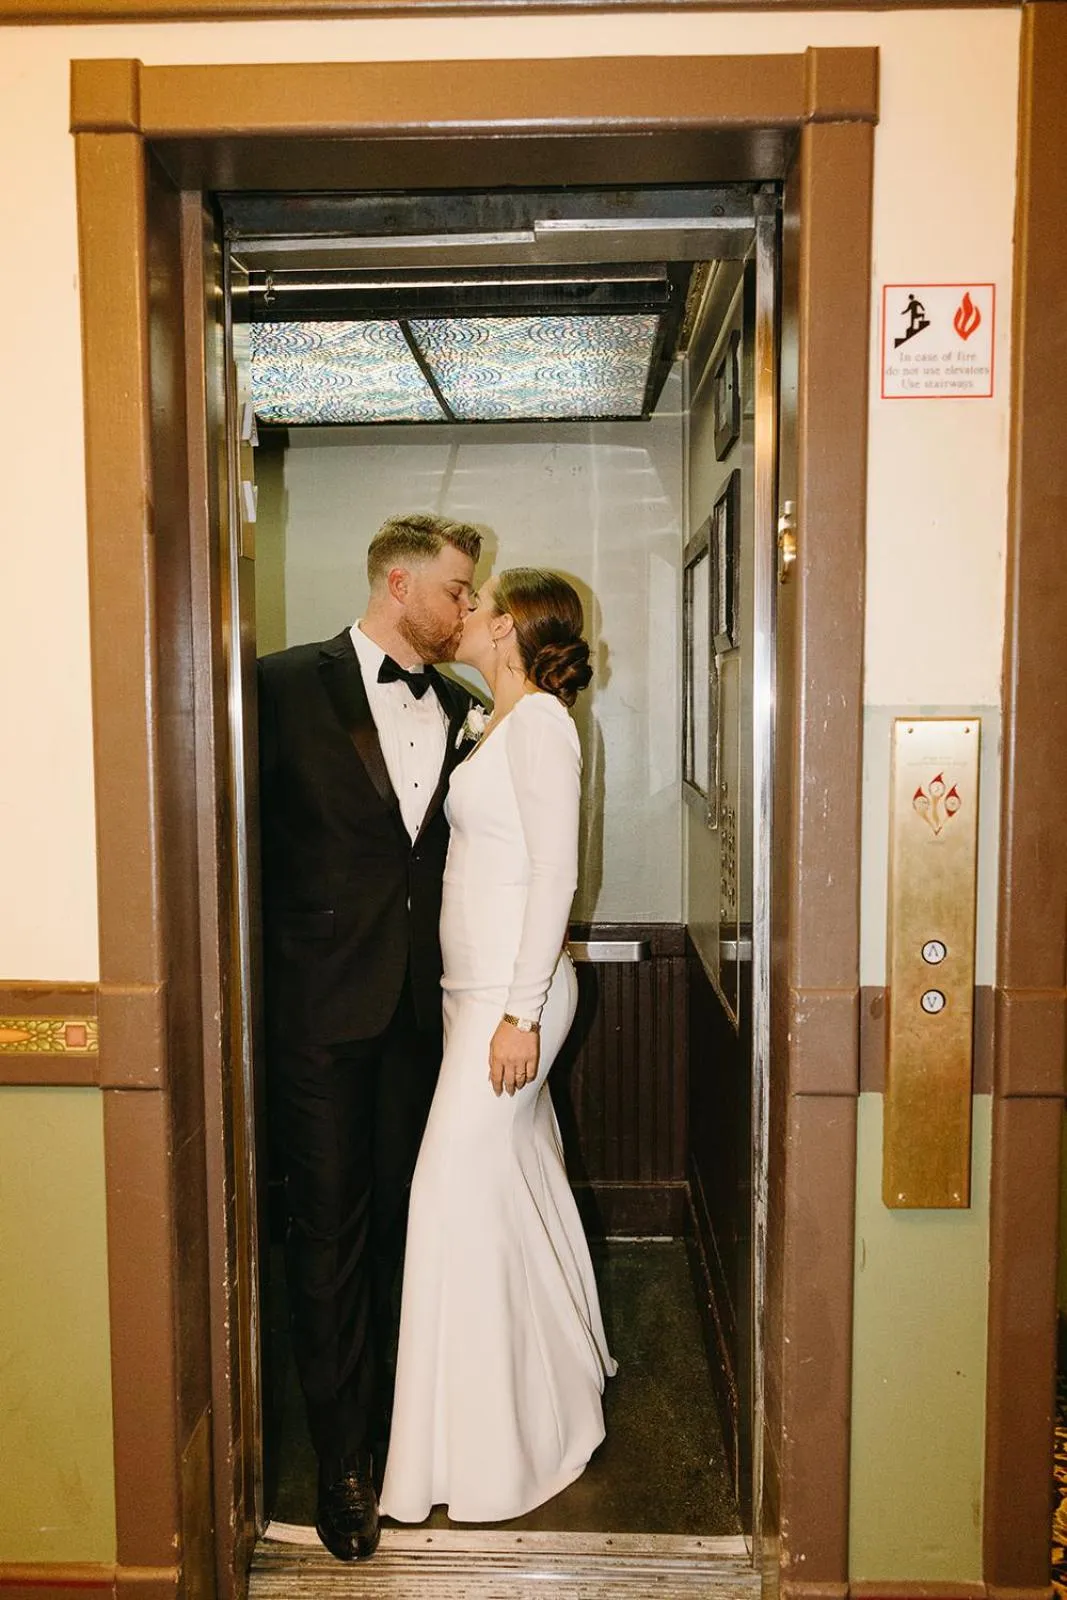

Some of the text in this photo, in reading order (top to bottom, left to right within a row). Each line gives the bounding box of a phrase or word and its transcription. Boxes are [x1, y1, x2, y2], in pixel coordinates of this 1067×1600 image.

[899, 351, 977, 362] In case of fire
[886, 365, 989, 375] do not use elevators
[901, 379, 920, 388] Use
